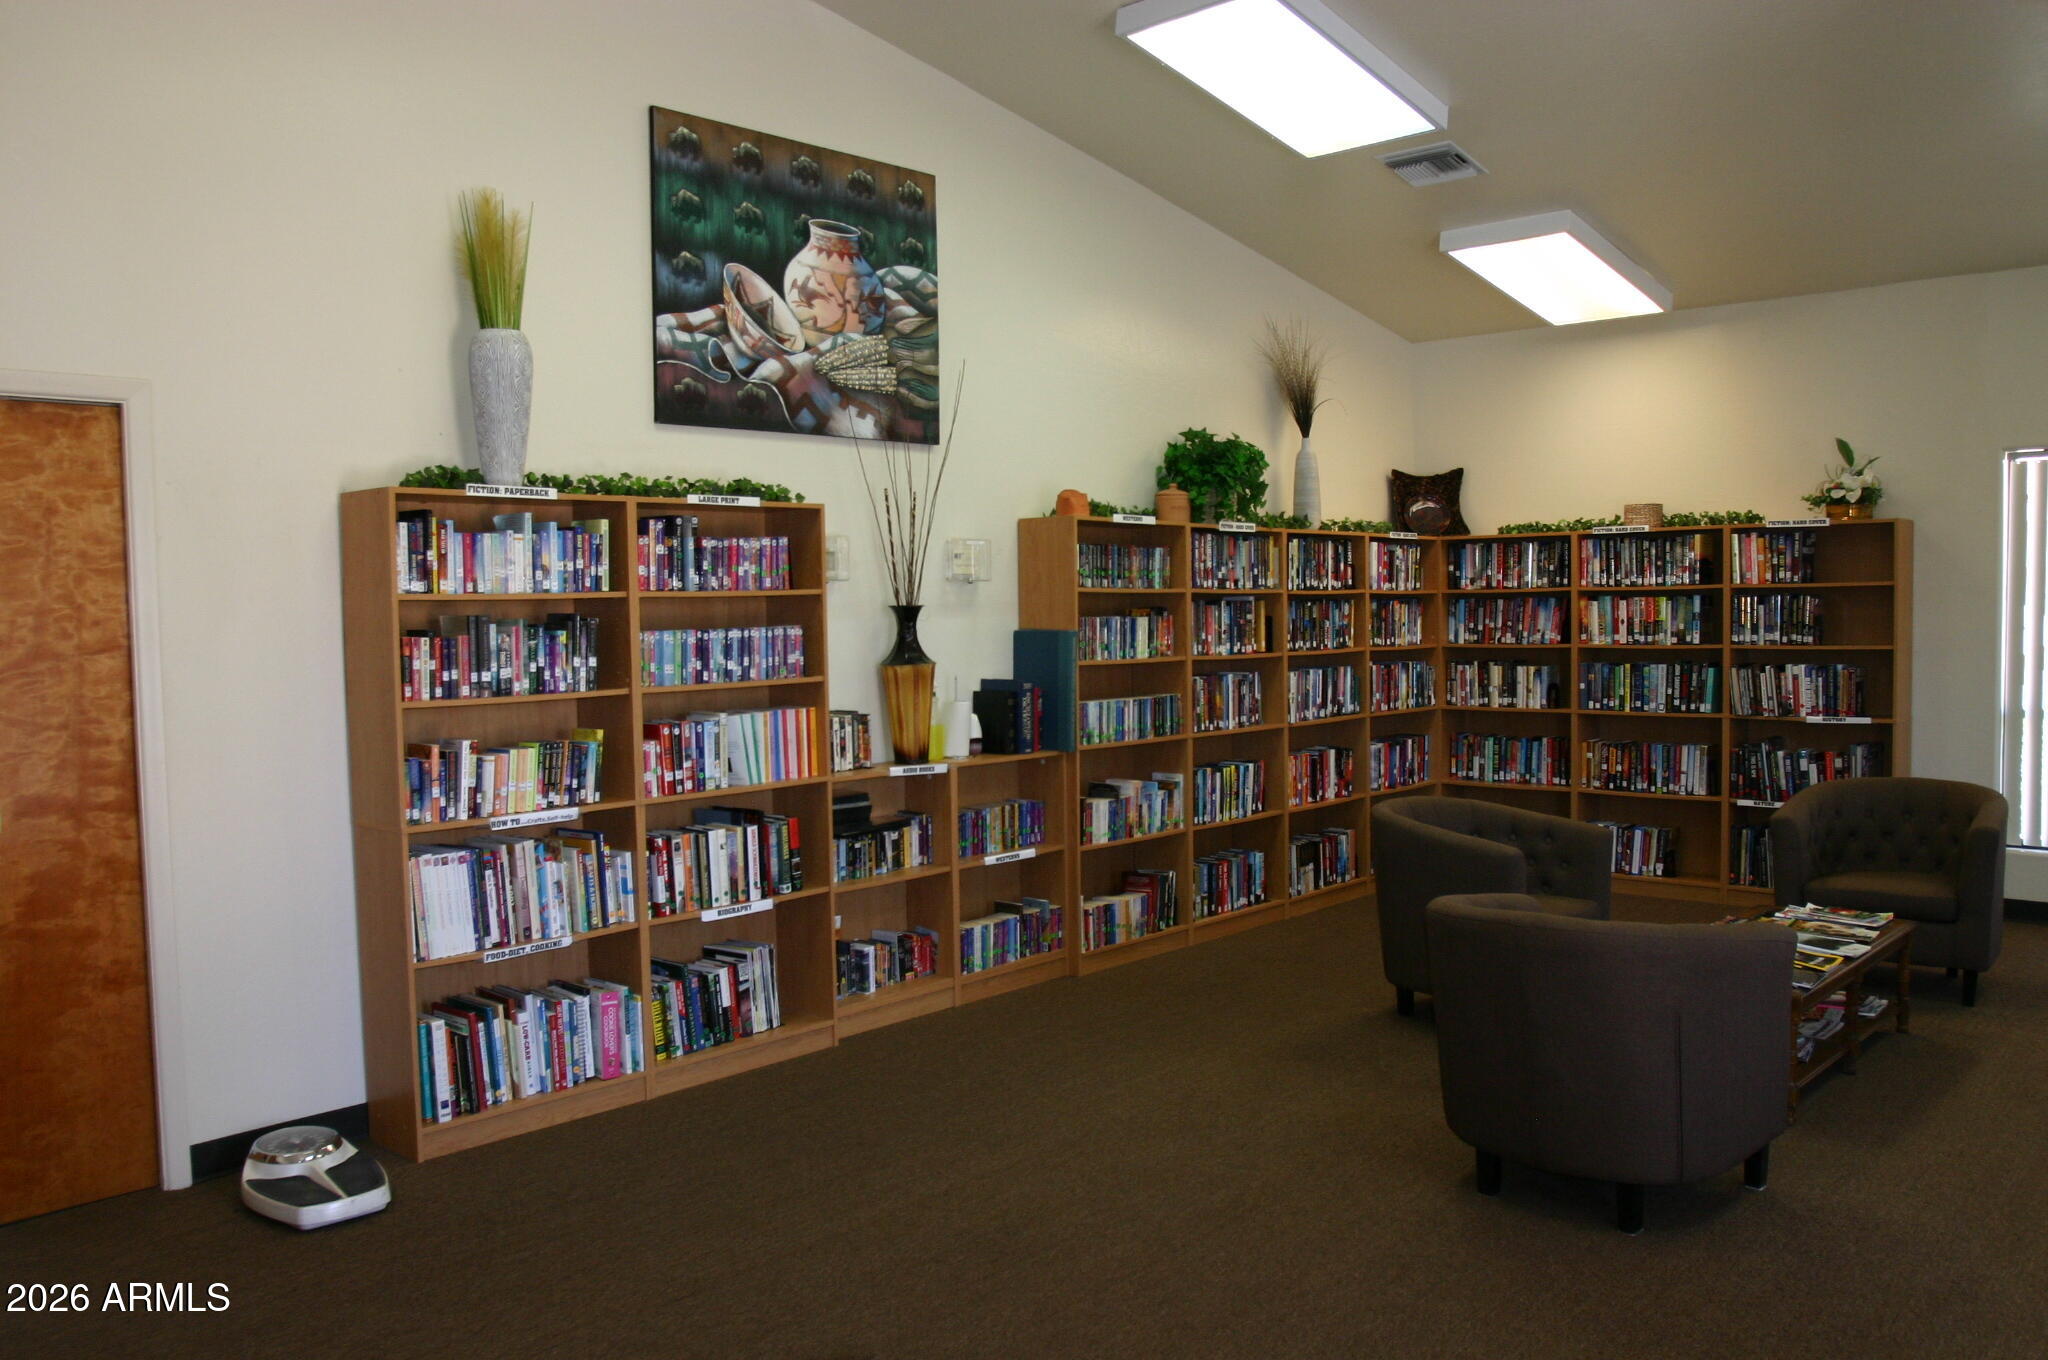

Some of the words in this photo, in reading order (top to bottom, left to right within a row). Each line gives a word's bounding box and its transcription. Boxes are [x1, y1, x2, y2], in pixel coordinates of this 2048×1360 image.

[467, 485, 503, 494] FICTION:
[504, 487, 550, 497] PAPERBACK
[698, 495, 720, 504] LARGE
[720, 497, 740, 505] PRINT
[491, 820, 508, 829] HOW
[717, 904, 753, 917] BIOGRAPHY
[485, 947, 529, 961] FOOD-DIET,
[530, 939, 563, 953] COOKING
